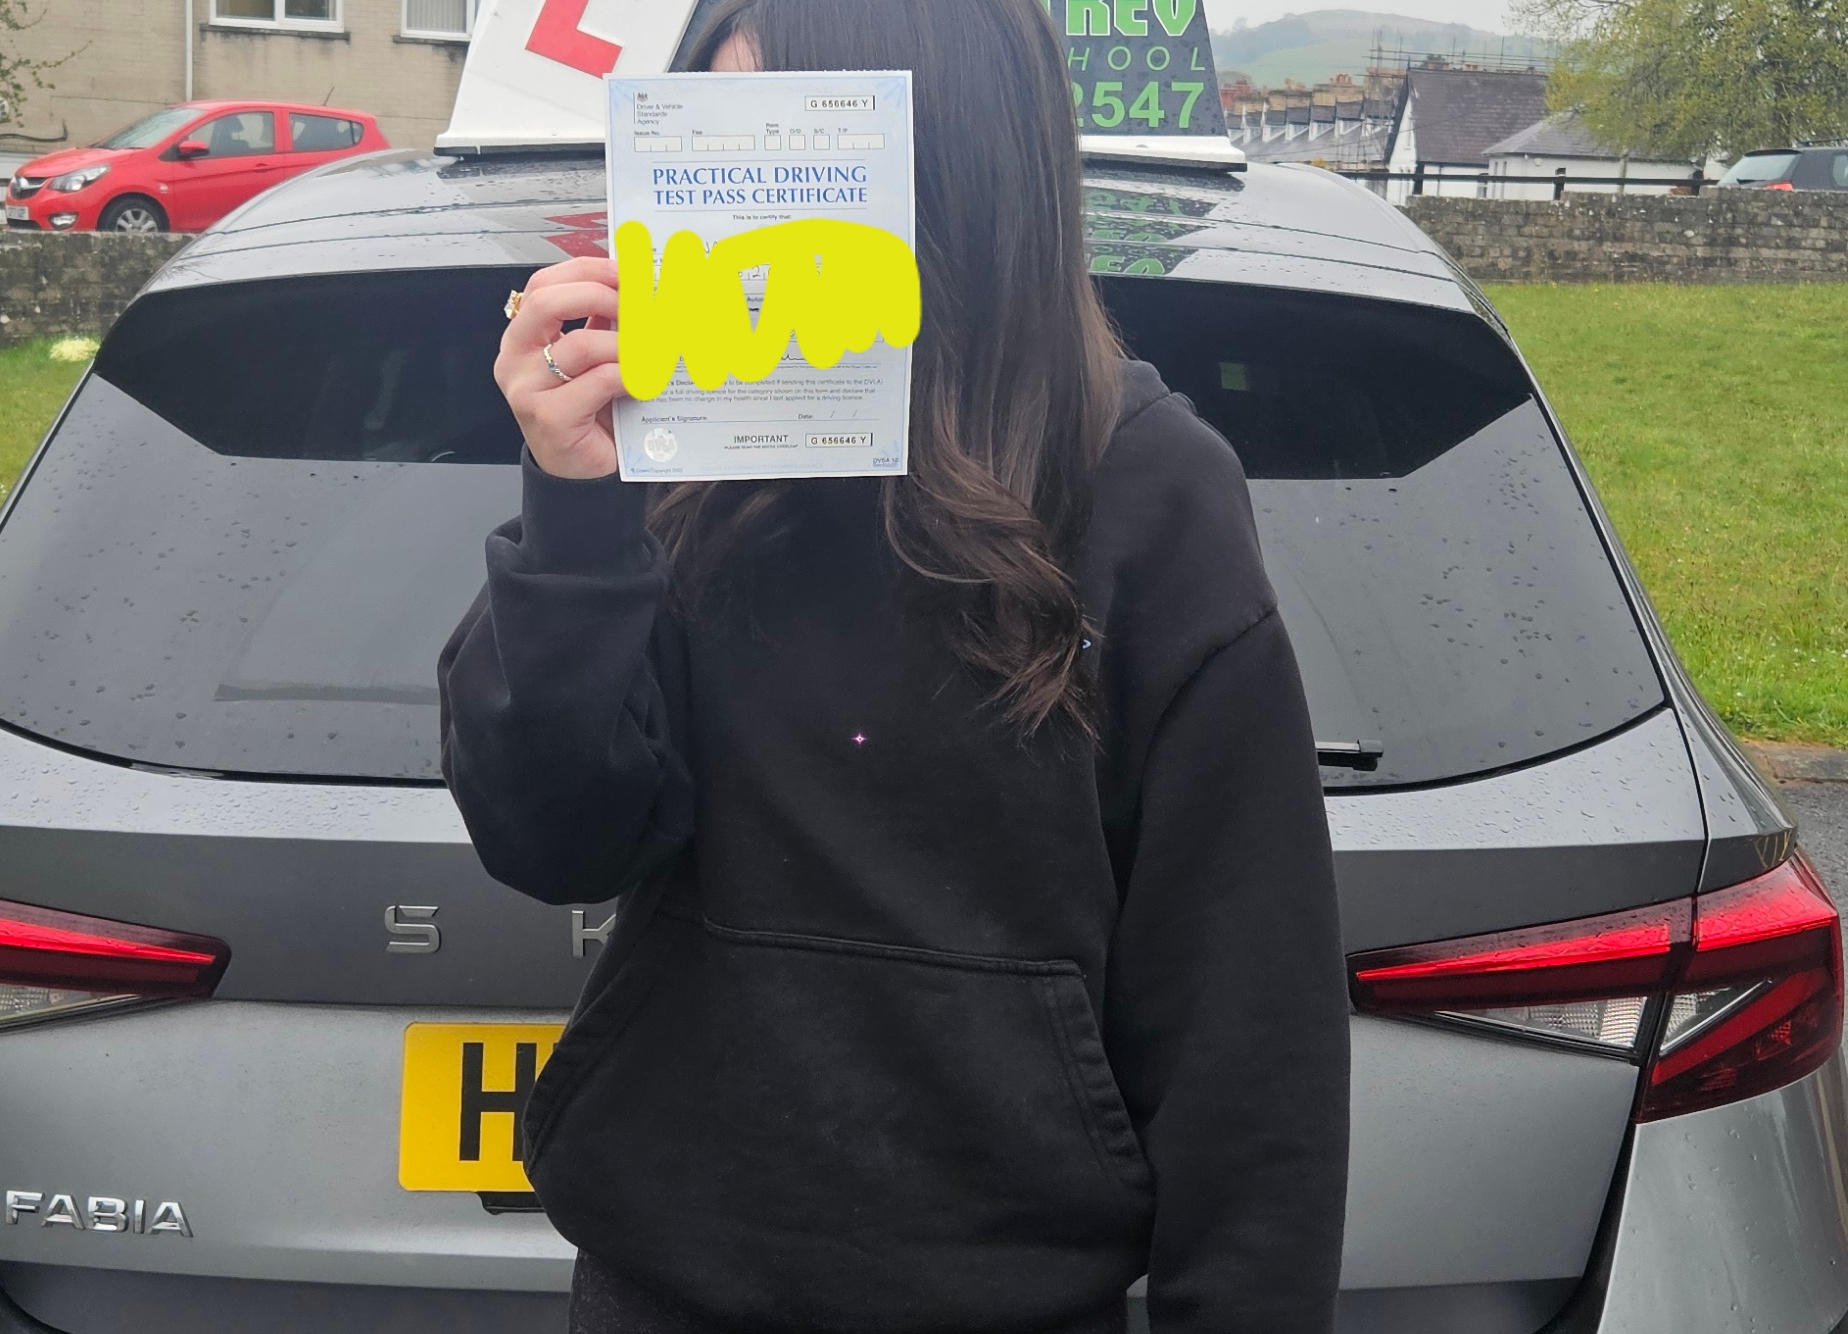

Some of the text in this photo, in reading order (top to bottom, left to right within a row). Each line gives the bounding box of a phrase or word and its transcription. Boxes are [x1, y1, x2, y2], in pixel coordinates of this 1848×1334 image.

[861, 98, 868, 107] Y
[652, 165, 867, 186] PRACTICAL DRIVING
[654, 187, 868, 206] TEST PASS CERTIFICATE
[733, 434, 789, 444] IMPORTANT
[860, 435, 867, 444] Y
[458, 1041, 559, 1162] H
[4, 1188, 194, 1239] FABIA
